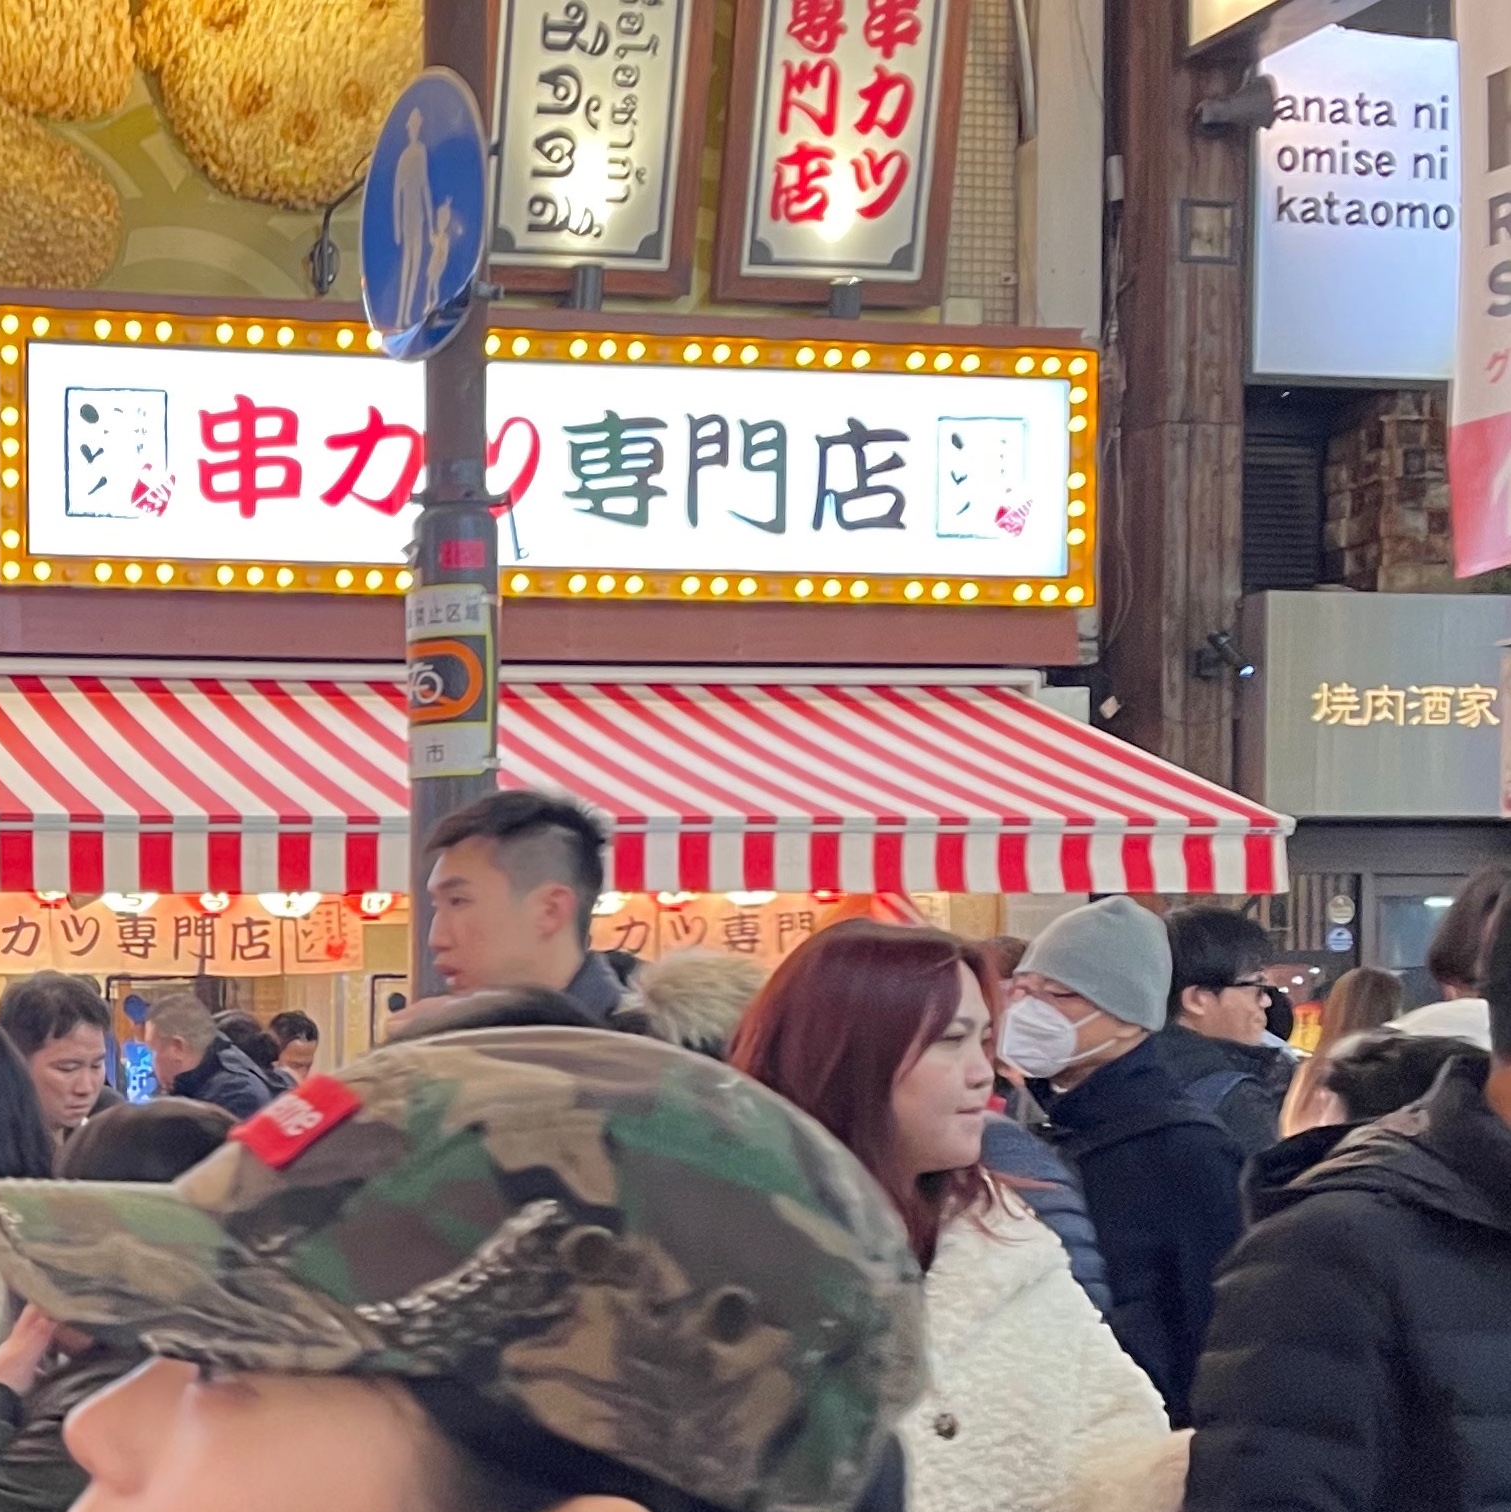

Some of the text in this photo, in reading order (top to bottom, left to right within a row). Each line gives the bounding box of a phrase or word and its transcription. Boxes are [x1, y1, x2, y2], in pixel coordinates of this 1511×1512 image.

[1273, 92, 1449, 131] anata ni
[1277, 140, 1448, 180] omise ni
[1276, 186, 1455, 231] kataomo
[1311, 681, 1500, 728] 焼肉酒家
